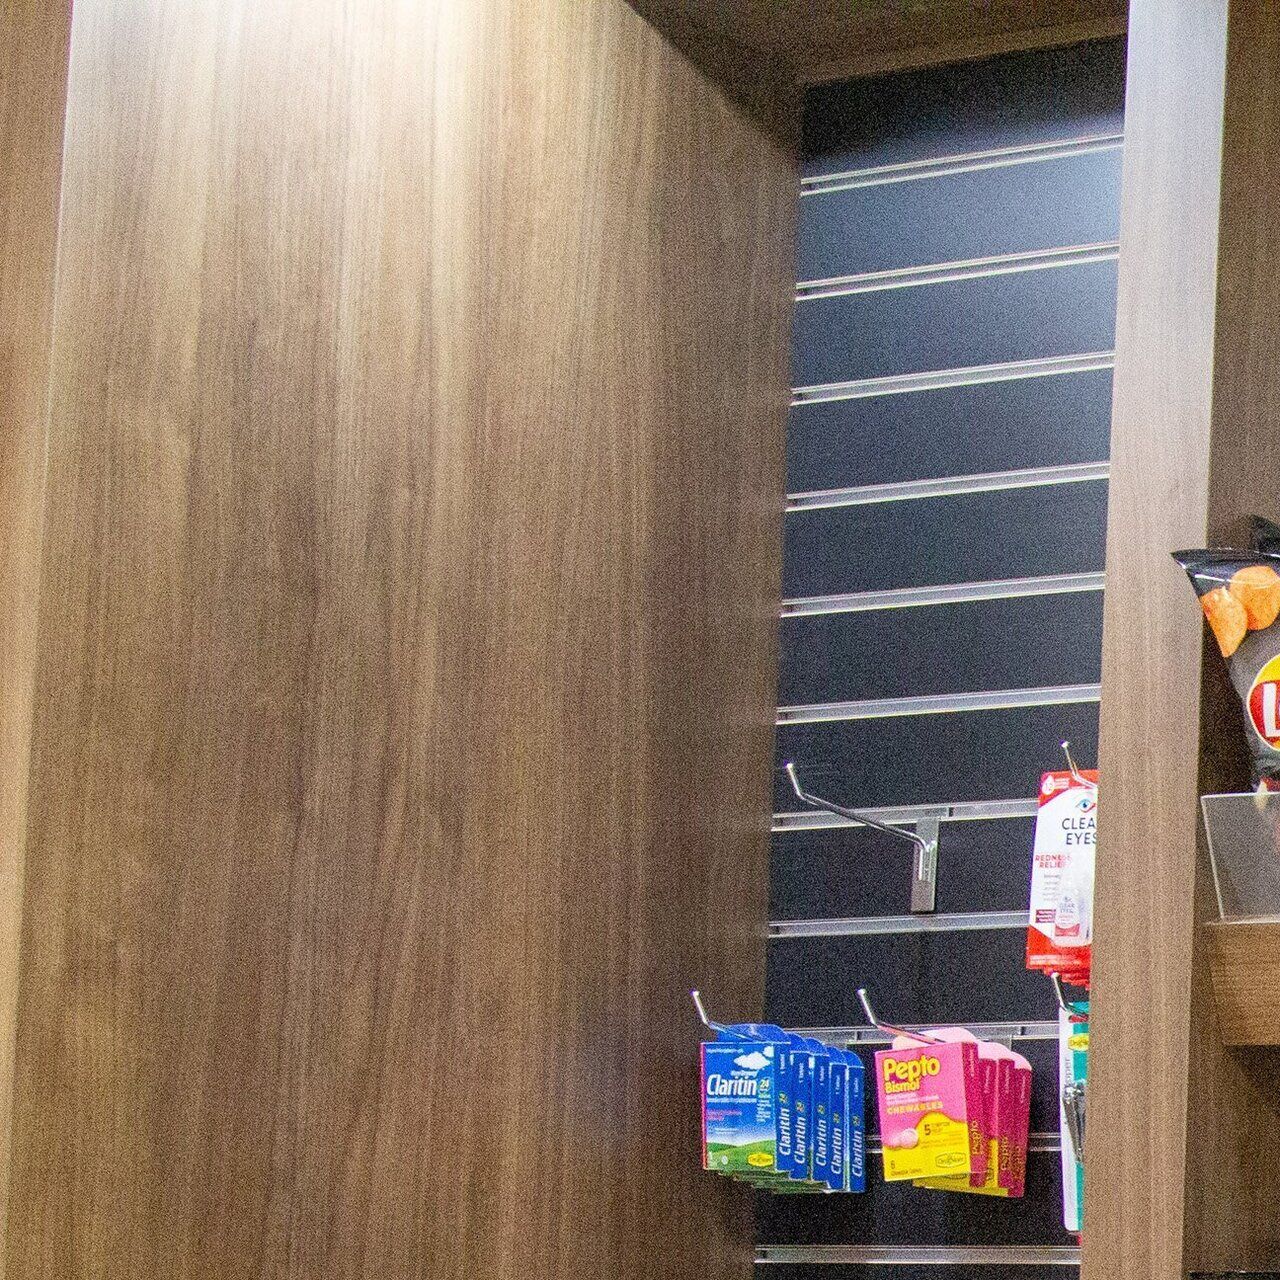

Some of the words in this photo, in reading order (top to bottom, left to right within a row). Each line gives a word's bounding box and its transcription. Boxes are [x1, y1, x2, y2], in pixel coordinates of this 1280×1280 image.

[1062, 817, 1096, 831] CLEA
[707, 1073, 757, 1097] Claritin
[883, 1055, 941, 1082] Pepto
[885, 1080, 921, 1094] Bismol
[779, 1108, 791, 1156] Claritin
[794, 1117, 806, 1165] Claritin
[816, 1119, 827, 1167] Claritin
[924, 1125, 931, 1136] 5
[831, 1127, 842, 1175] Claritin
[852, 1130, 863, 1177] Claritin
